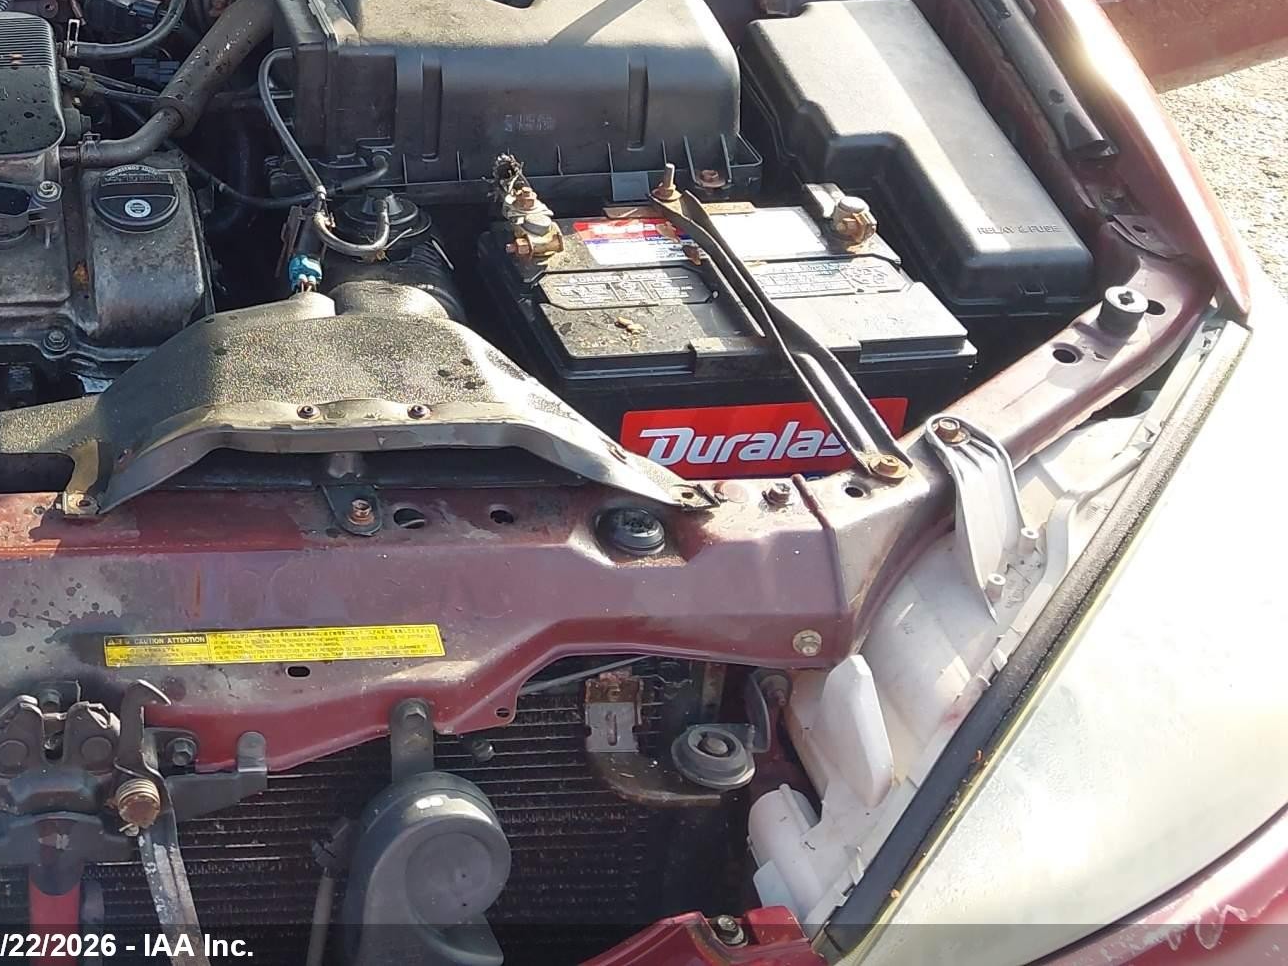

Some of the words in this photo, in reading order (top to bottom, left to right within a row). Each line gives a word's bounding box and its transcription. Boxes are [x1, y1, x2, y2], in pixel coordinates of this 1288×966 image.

[976, 226, 1015, 235] RELAY
[1028, 224, 1063, 234] FUSE
[639, 421, 848, 467] Duralas
[134, 636, 164, 645] CAUTION
[166, 635, 205, 645] ATTENTION
